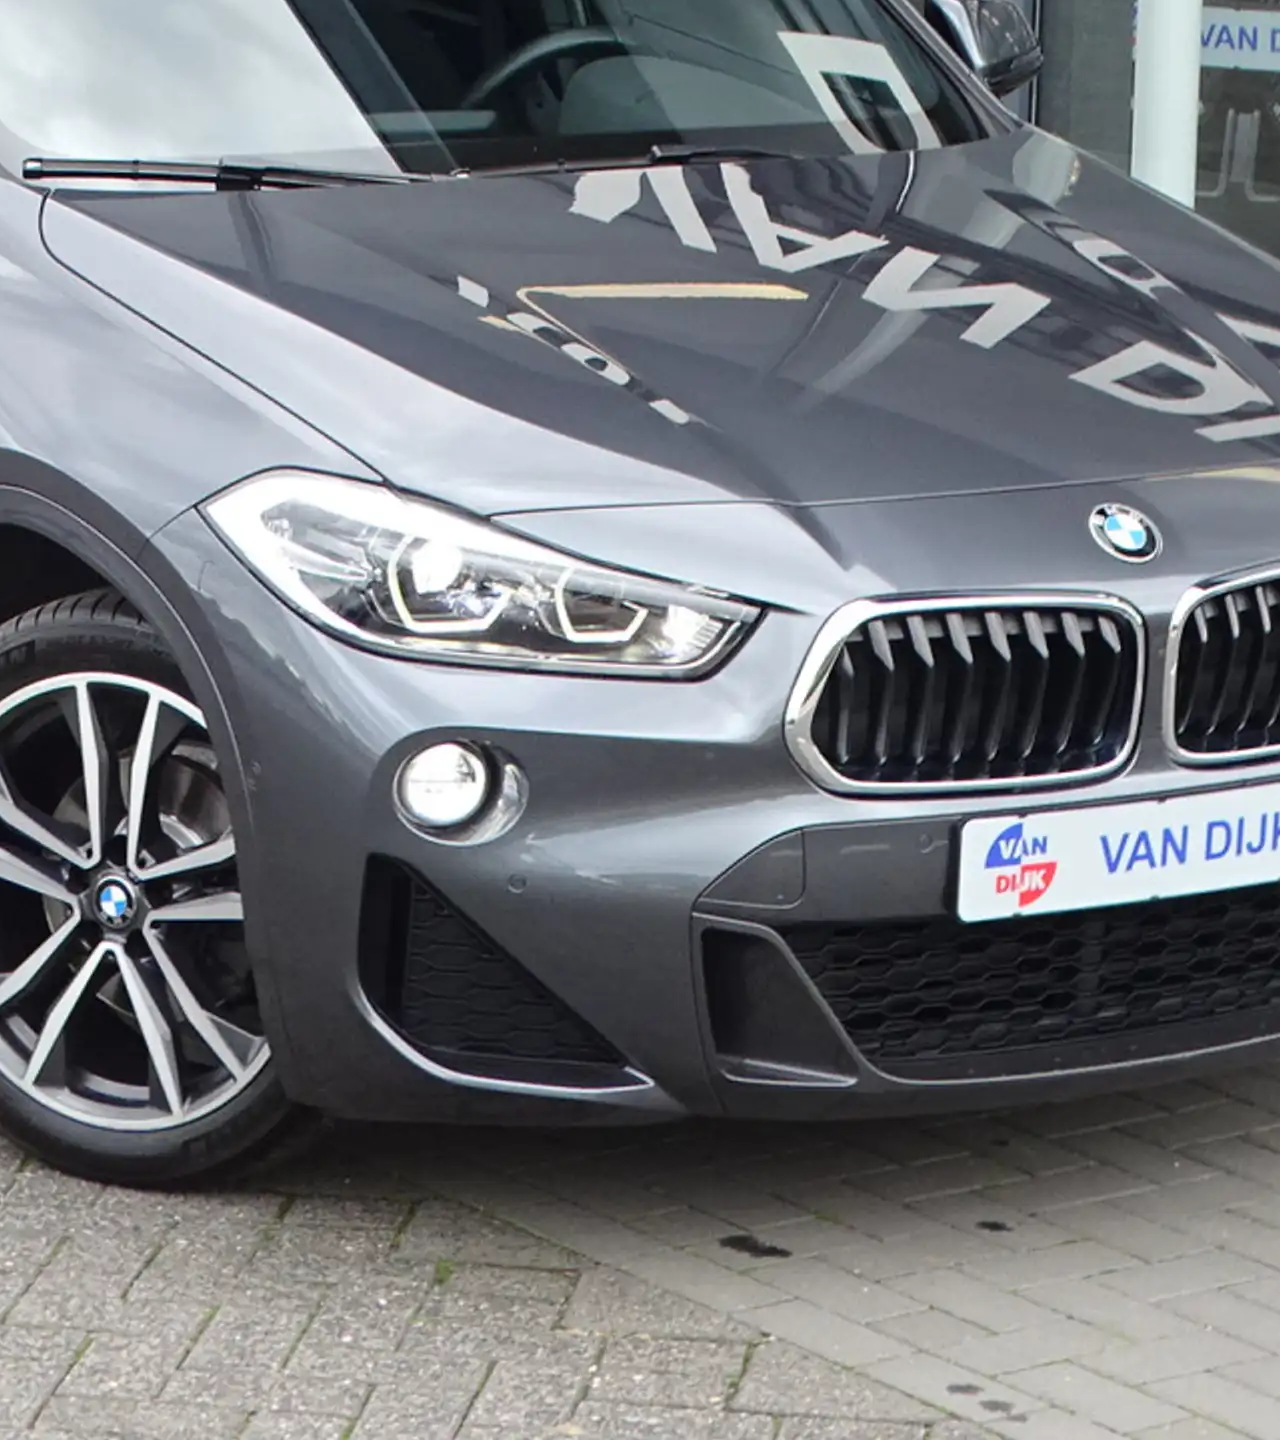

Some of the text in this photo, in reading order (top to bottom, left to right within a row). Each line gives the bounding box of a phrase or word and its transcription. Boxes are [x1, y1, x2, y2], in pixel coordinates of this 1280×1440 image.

[997, 835, 1048, 860] VAN
[1100, 825, 1190, 874] VAN
[995, 870, 1047, 895] DIJK
